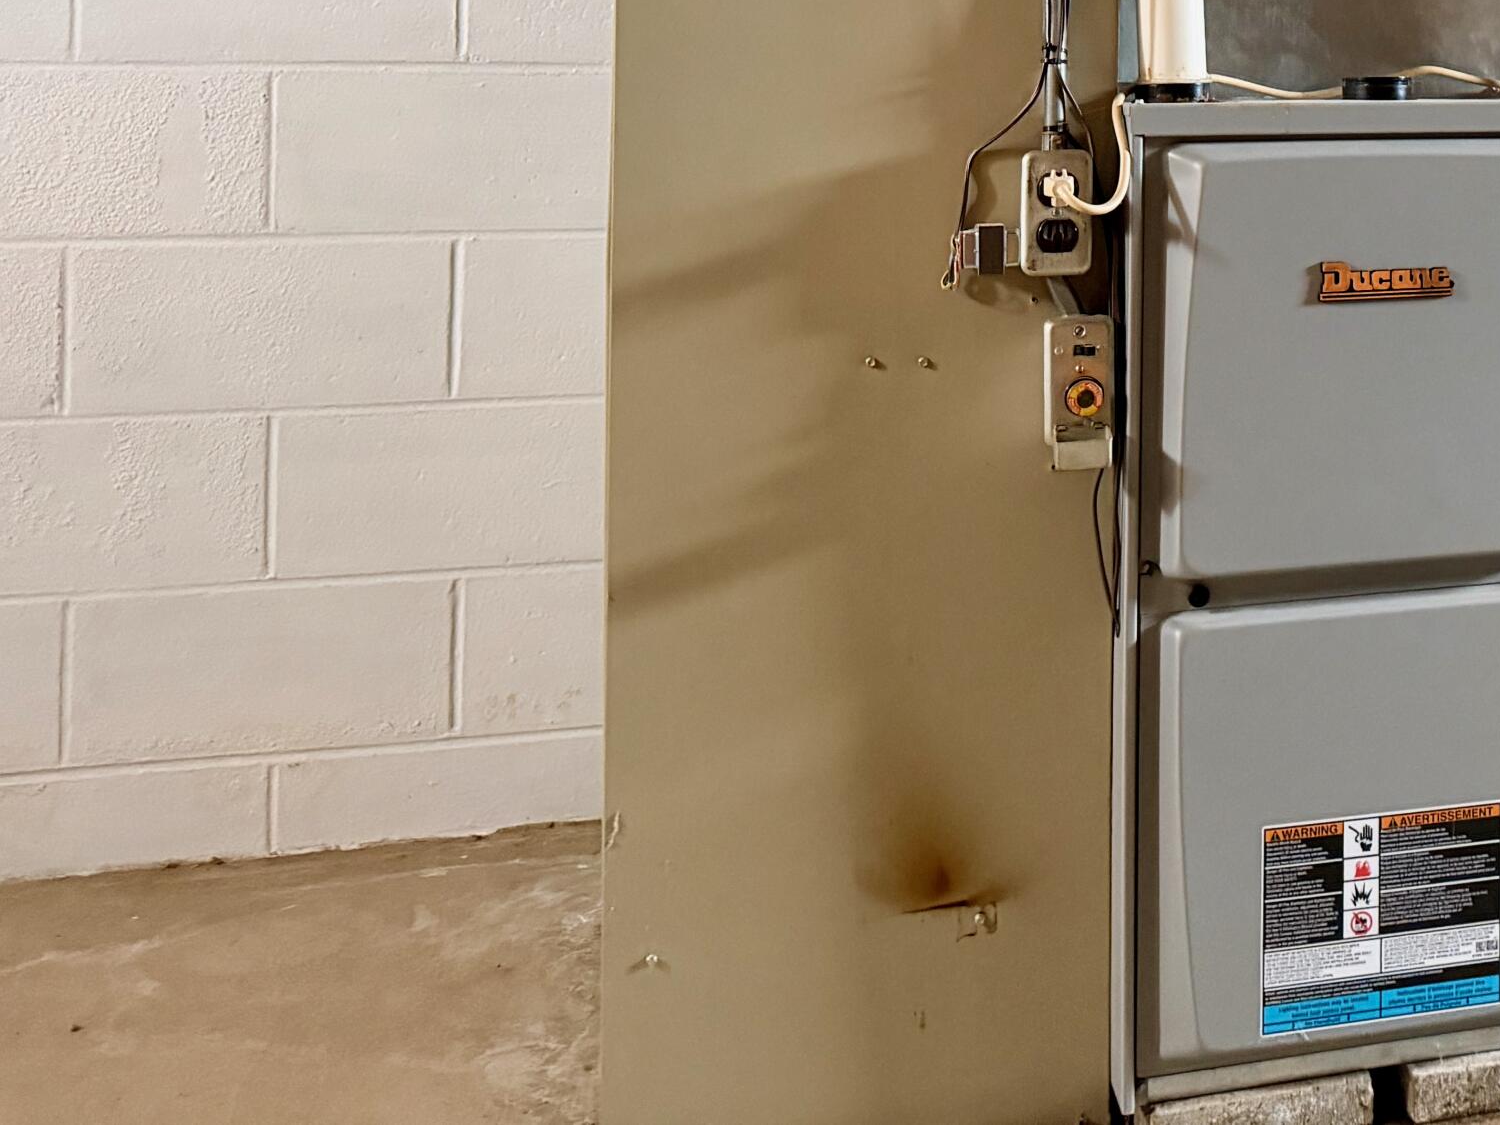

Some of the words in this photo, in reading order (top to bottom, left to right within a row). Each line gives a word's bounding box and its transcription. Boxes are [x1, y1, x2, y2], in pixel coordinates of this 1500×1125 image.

[1320, 261, 1453, 293] Ducane
[1400, 806, 1494, 827] AVERTISSEMENT
[1282, 824, 1338, 841] WARNING
